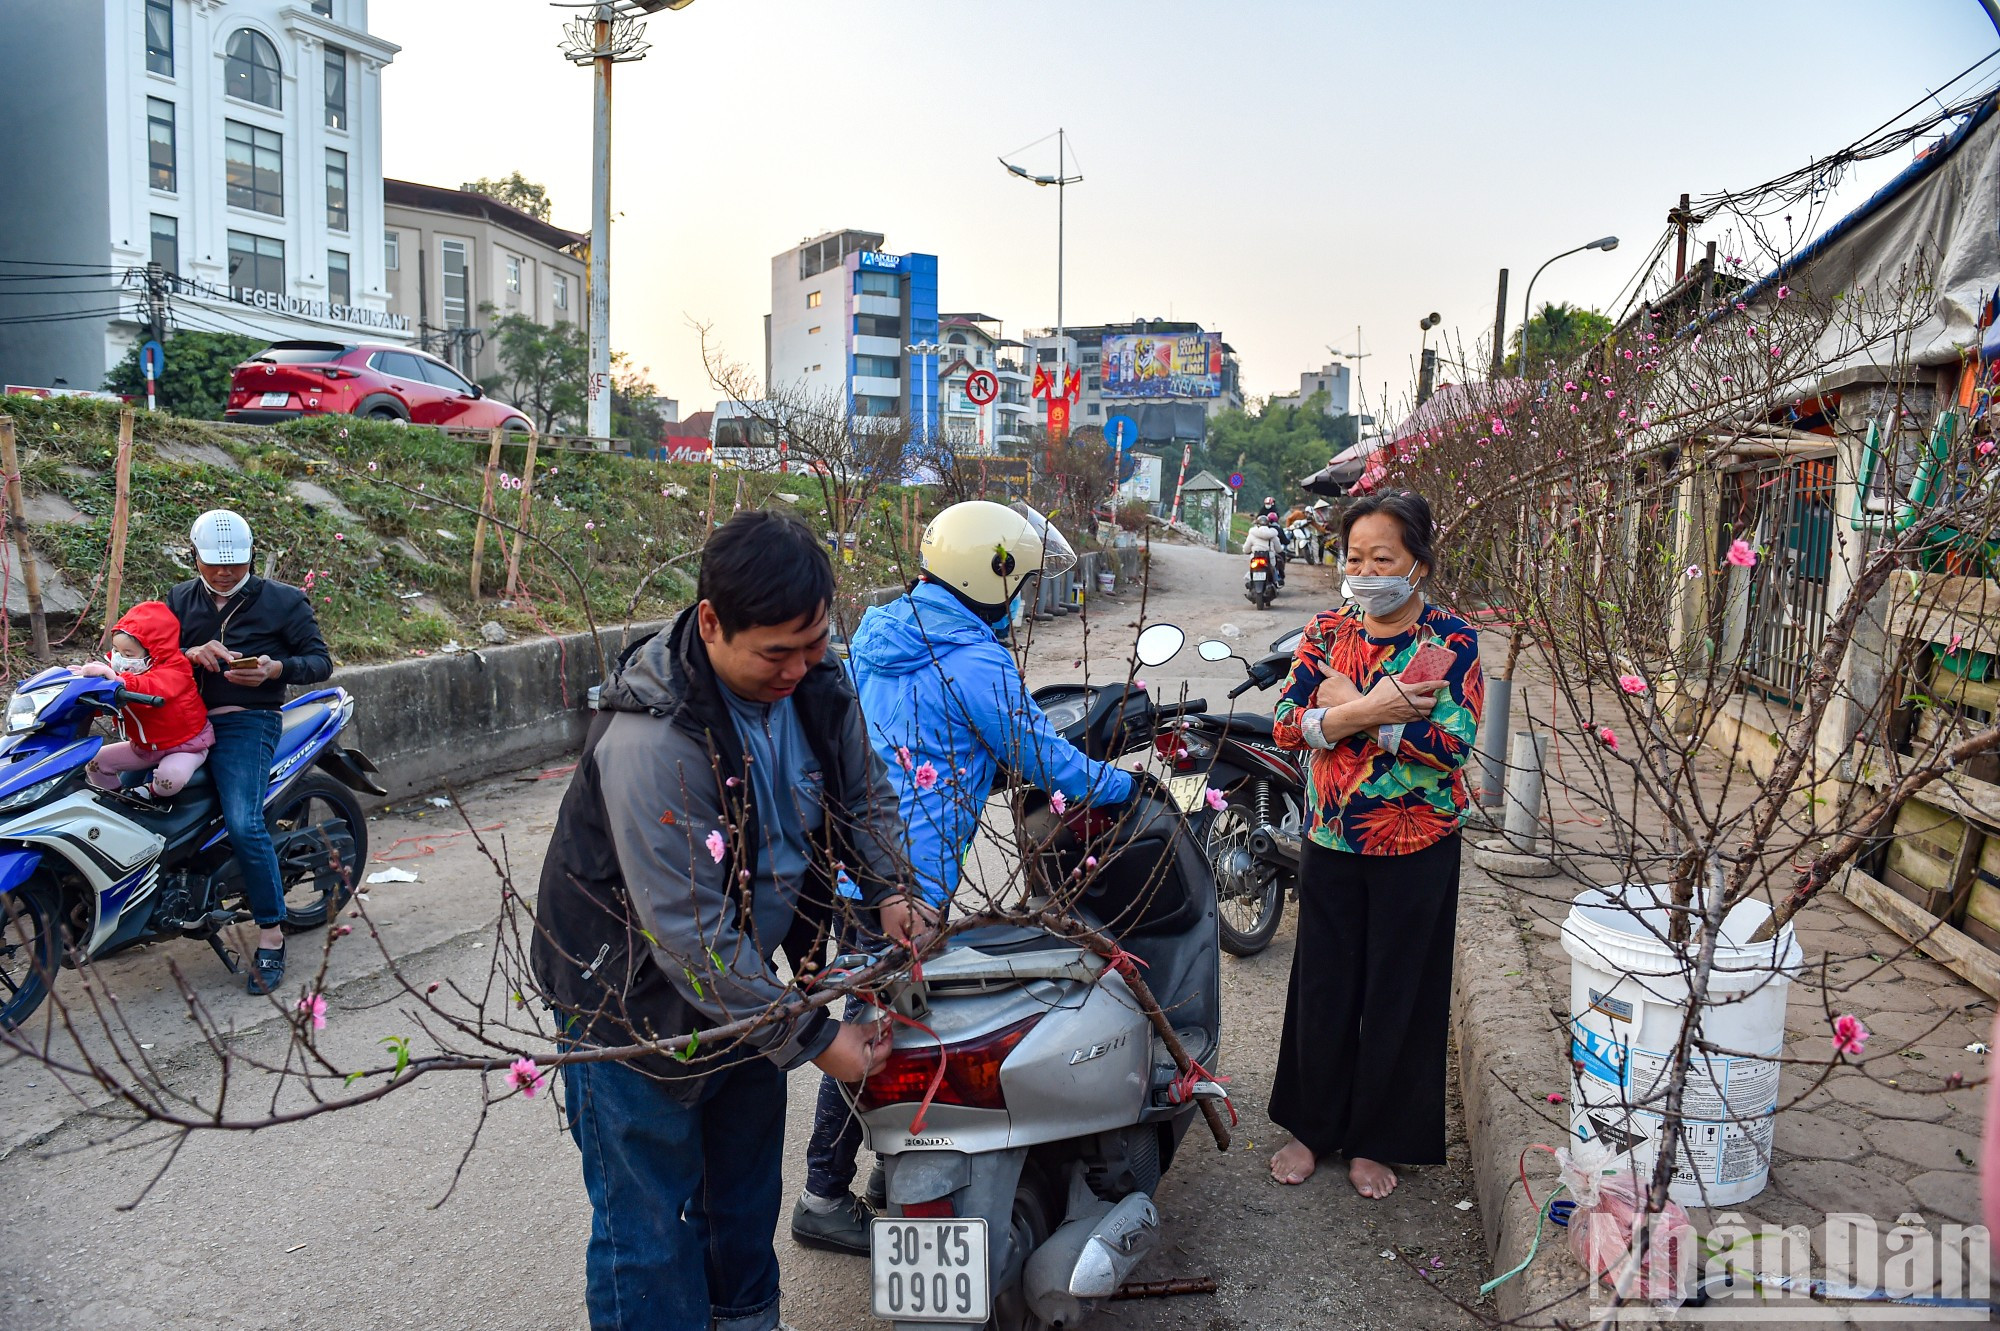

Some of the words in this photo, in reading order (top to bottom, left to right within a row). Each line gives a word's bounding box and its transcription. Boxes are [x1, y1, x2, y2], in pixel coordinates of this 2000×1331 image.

[230, 285, 301, 314] LEGEND
[1166, 776, 1199, 795] 9-F1
[904, 1137, 954, 1147] HONDA
[888, 1225, 970, 1267] 30-K5
[888, 1271, 971, 1314] 0909
